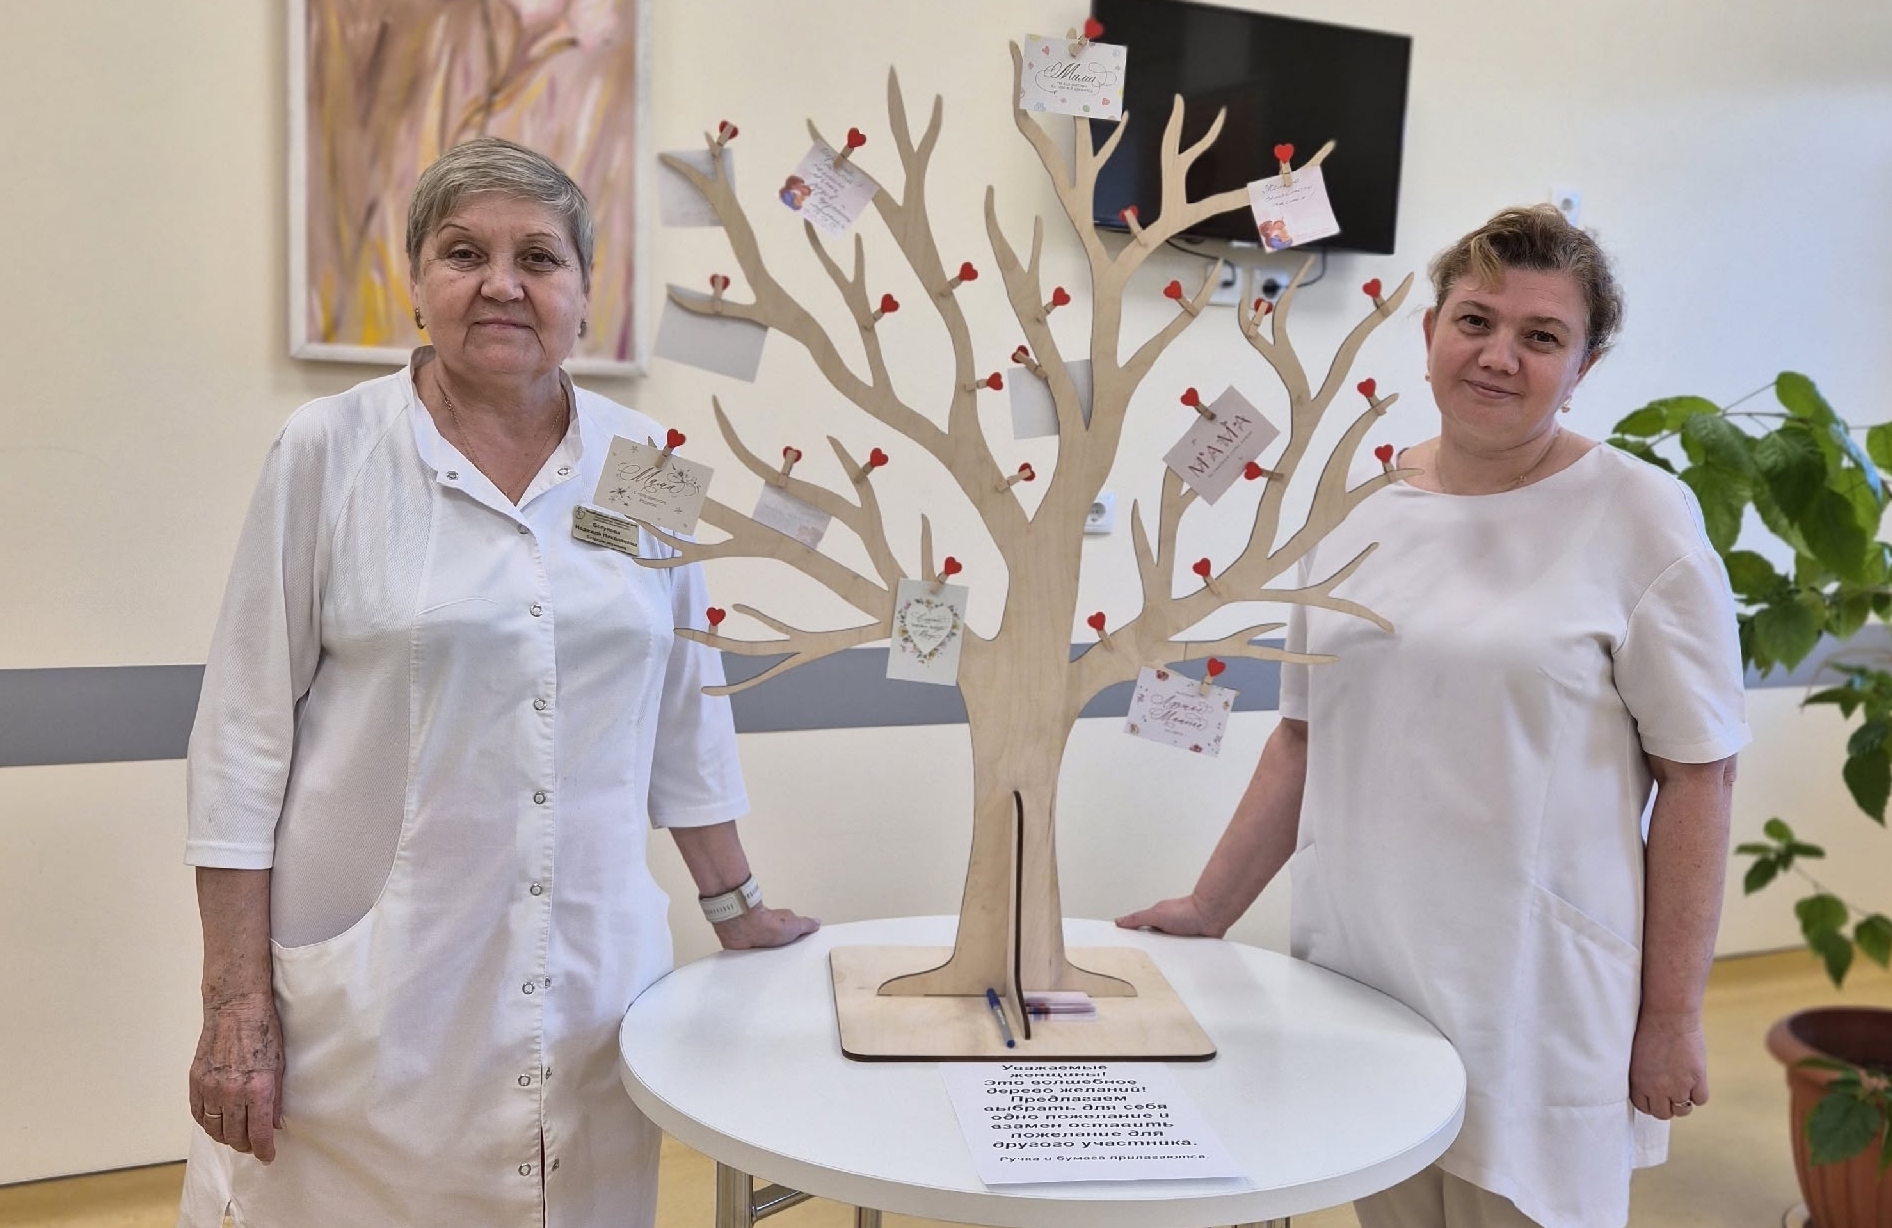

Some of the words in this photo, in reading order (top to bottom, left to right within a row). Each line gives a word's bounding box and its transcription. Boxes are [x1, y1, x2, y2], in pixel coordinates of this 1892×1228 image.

[1188, 415, 1252, 478] МАМА
[1031, 1078, 1138, 1086] волшебное
[986, 1087, 1054, 1095] дерево
[1010, 1095, 1127, 1104] Предлагаем
[984, 1104, 1076, 1112] выбрать
[1082, 1103, 1117, 1111] для
[1123, 1102, 1168, 1110] себя
[991, 1112, 1039, 1120] одно
[1045, 1112, 1154, 1120] пожелание
[991, 1122, 1062, 1130] взамен
[1011, 1131, 1122, 1139] пожелание
[1128, 1129, 1164, 1137] для
[992, 1140, 1075, 1149] другого
[1081, 1139, 1198, 1149] участника.
[1056, 1155, 1106, 1163] бумага
